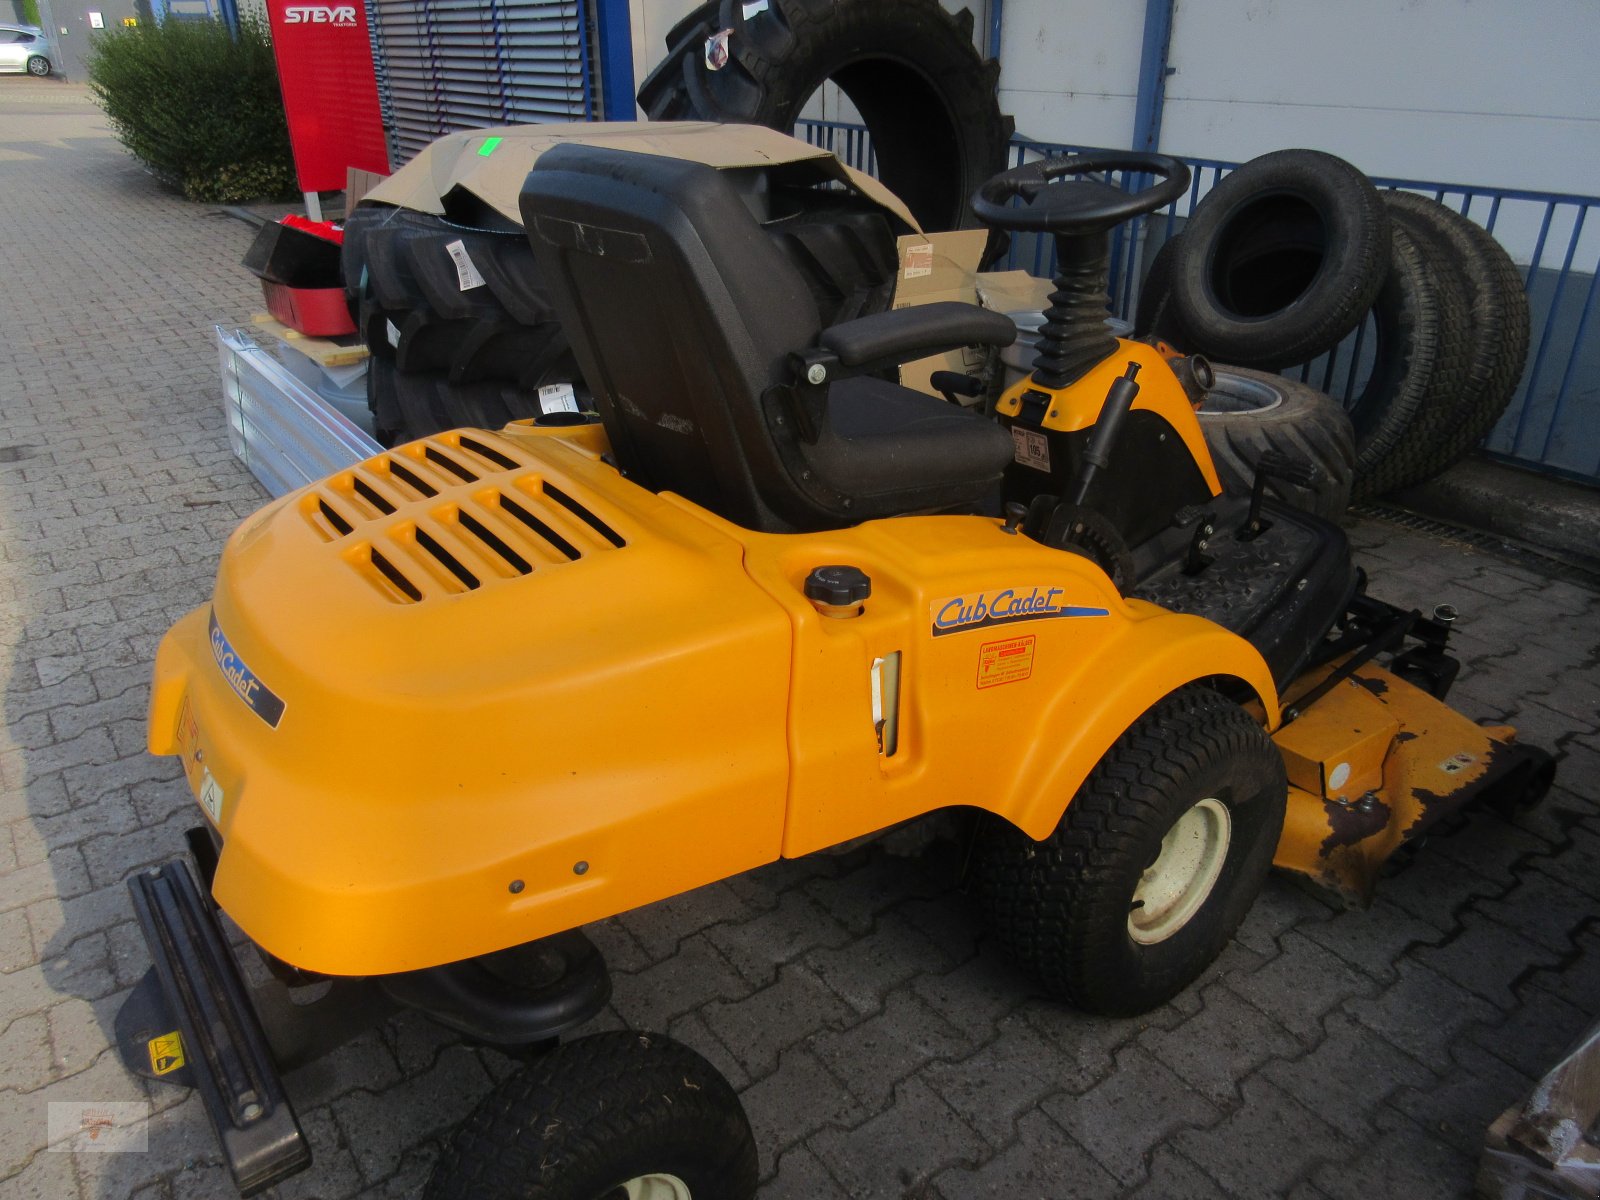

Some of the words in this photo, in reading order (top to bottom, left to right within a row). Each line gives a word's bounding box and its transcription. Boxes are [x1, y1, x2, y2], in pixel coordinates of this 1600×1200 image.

[284, 6, 356, 23] STEYR
[936, 594, 987, 627] Cub
[990, 587, 1064, 617] Cadet
[211, 627, 225, 662] Cub
[221, 652, 260, 705] Cadet
